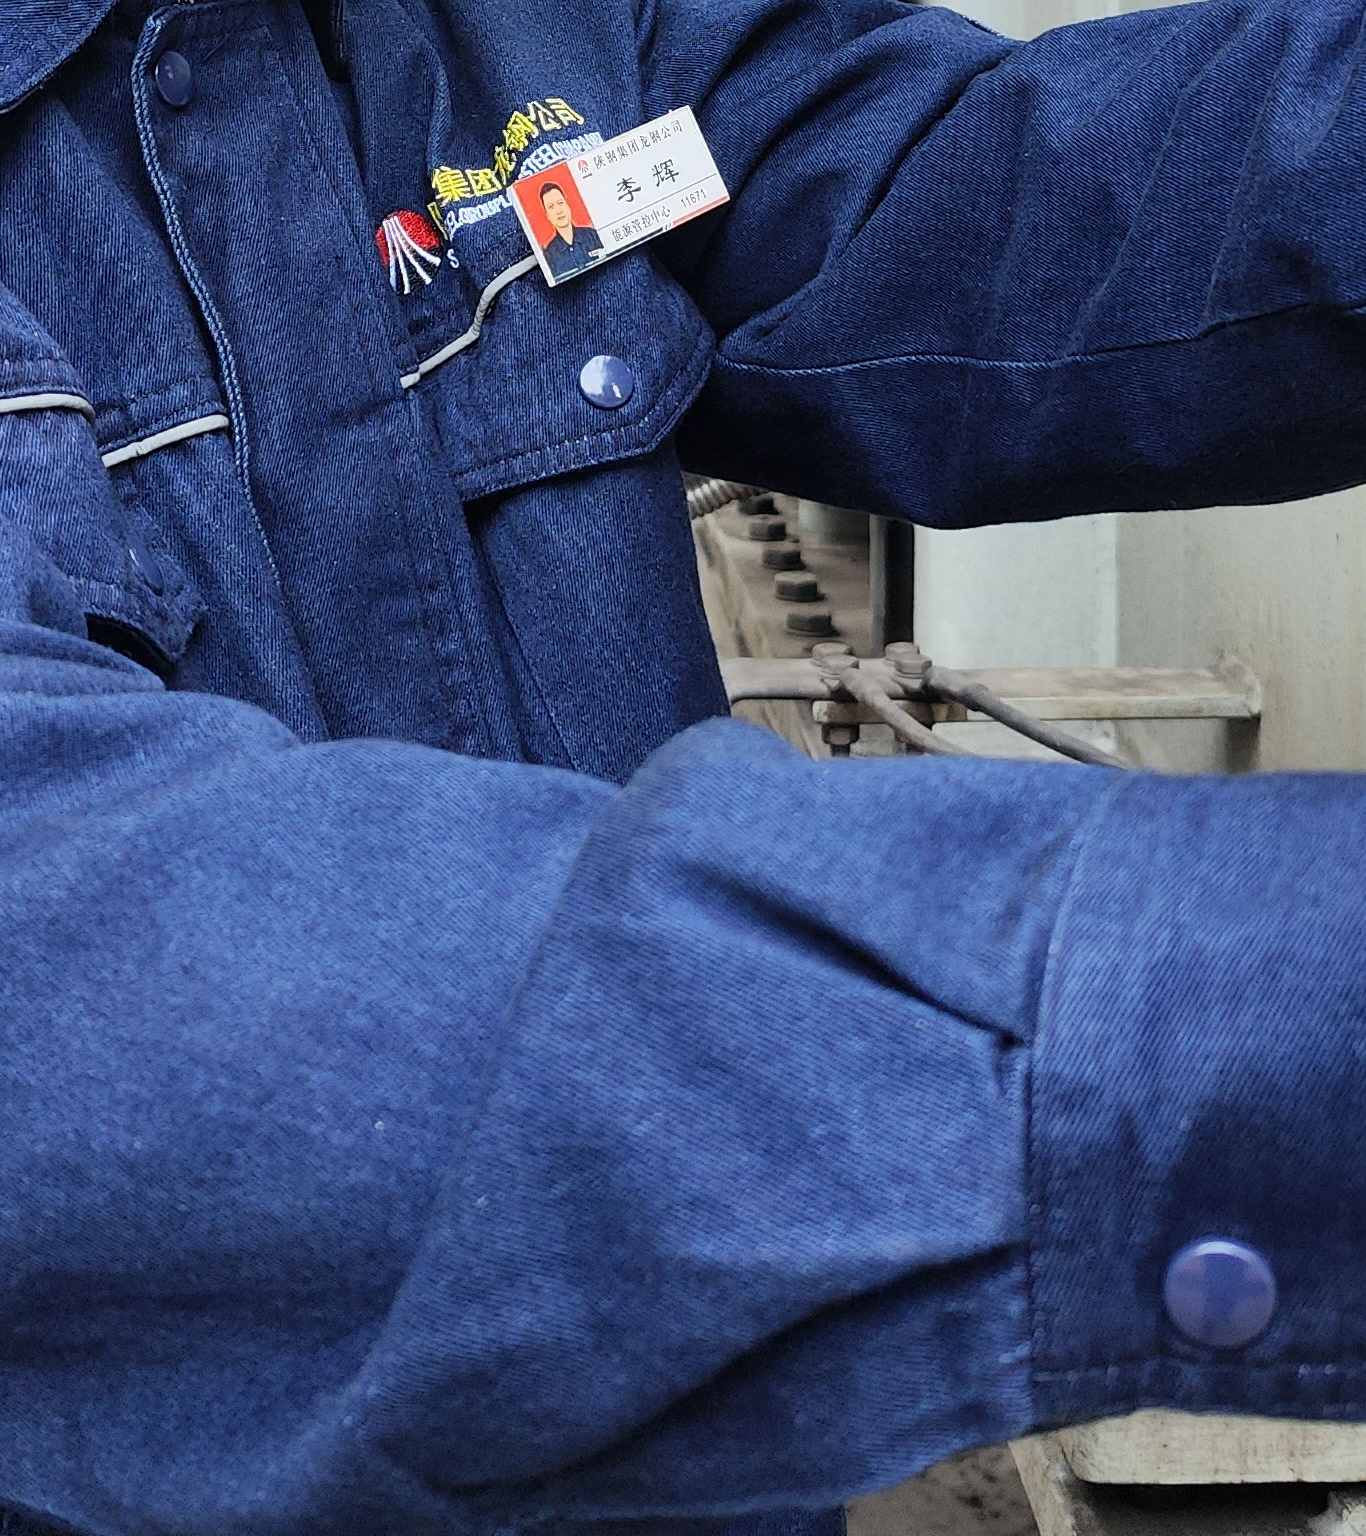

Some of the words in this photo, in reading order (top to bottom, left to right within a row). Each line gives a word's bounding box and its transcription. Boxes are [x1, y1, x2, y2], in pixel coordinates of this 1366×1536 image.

[593, 119, 684, 170] 陕钢集团龙钢公司
[681, 190, 708, 208] 11671
